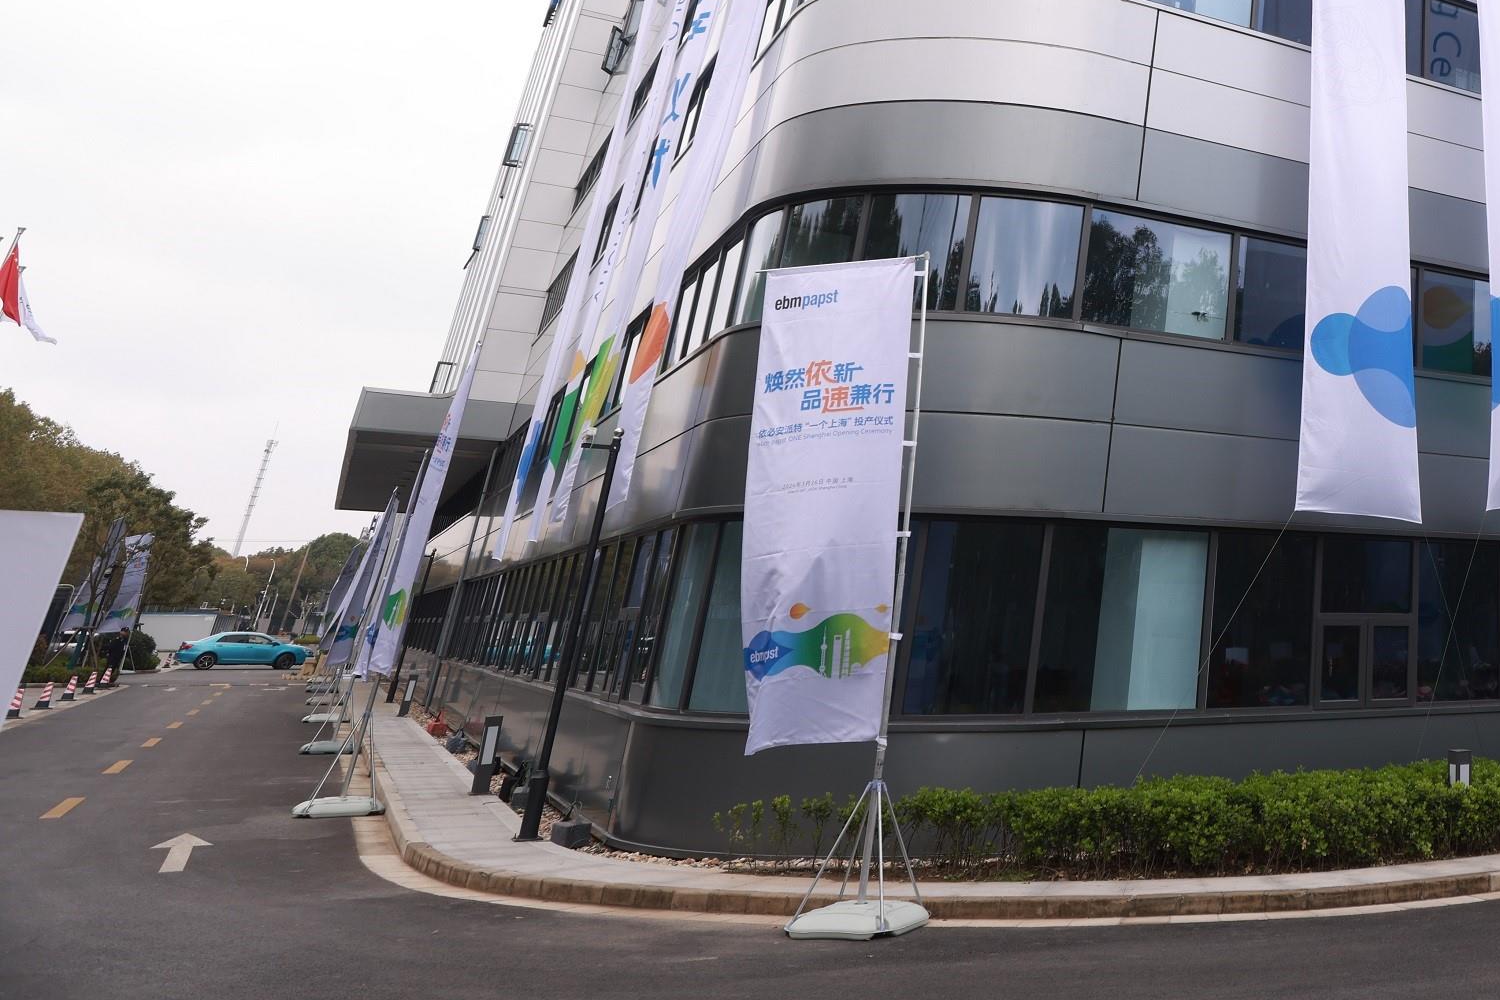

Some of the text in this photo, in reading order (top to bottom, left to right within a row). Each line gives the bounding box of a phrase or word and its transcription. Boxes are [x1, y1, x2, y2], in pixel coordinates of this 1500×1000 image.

[774, 289, 839, 311] ebmpapst
[763, 359, 864, 394] 焕然依新
[800, 383, 895, 413] 品速兼行
